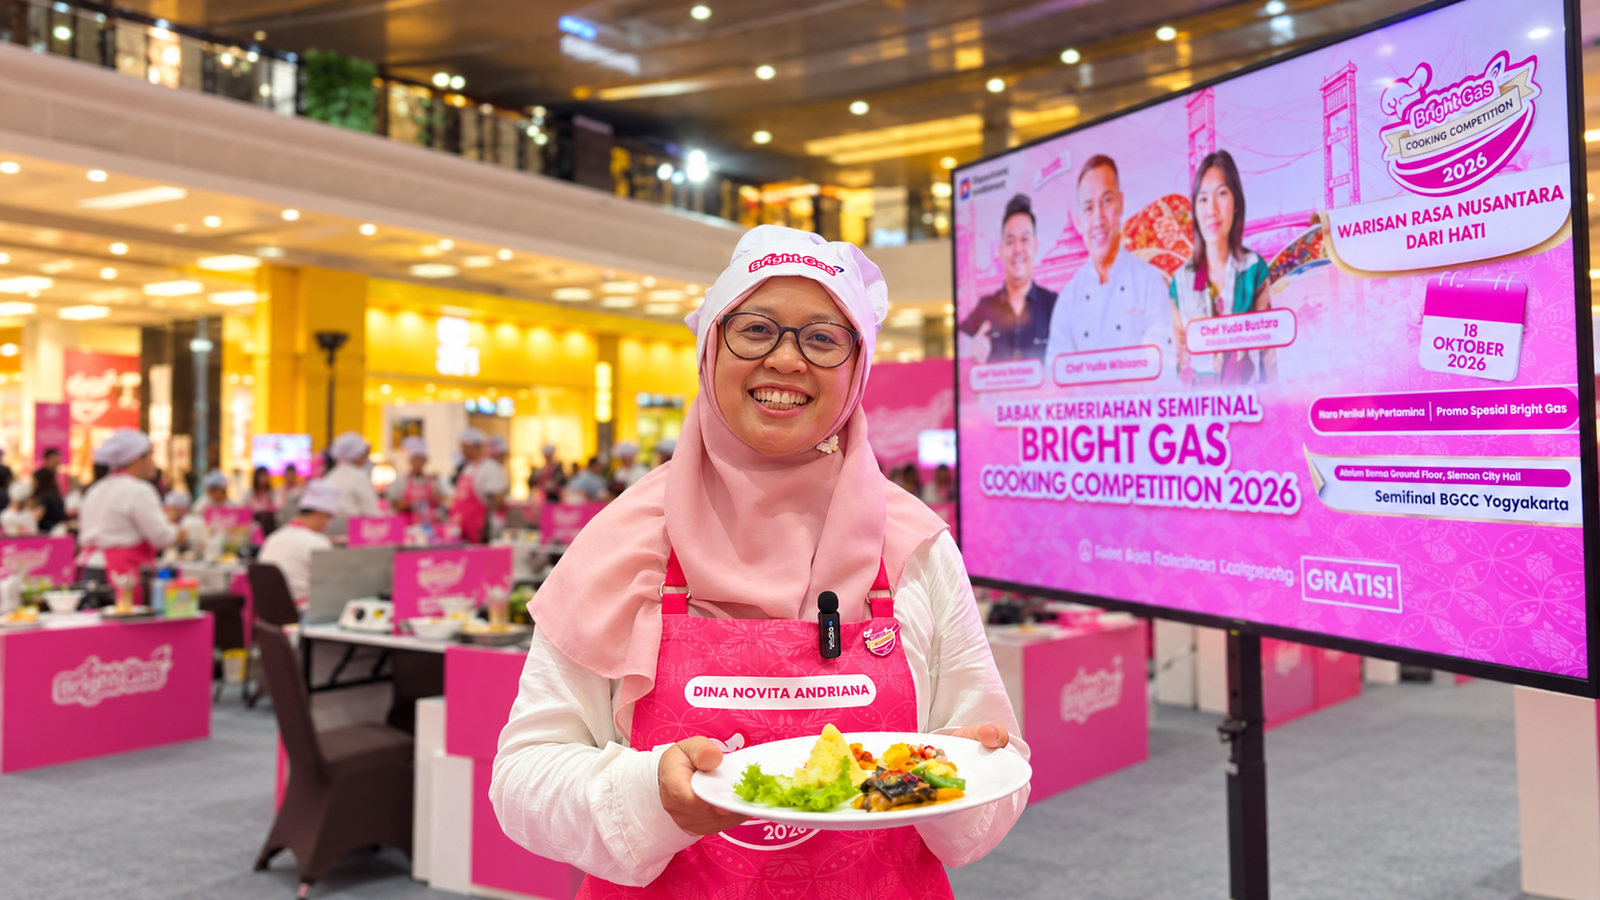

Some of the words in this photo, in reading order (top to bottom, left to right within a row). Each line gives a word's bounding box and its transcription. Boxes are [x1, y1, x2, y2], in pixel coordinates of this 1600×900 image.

[1413, 95, 1460, 128] Bright
[1461, 80, 1494, 107] Gas
[1405, 131, 1447, 151] COOKING
[1449, 97, 1514, 137] COMPETITION
[1442, 152, 1488, 183] 2026
[1337, 213, 1407, 238] WARISAN
[1412, 204, 1454, 226] RASA
[1457, 184, 1564, 218] NUSANTARA
[1406, 230, 1443, 249] DARI
[1449, 222, 1486, 244] HATI
[748, 253, 802, 273] Bright
[802, 255, 836, 276] Gas
[1463, 323, 1478, 338] 18
[1433, 336, 1504, 357] OKTOBER
[1447, 353, 1487, 371] 2026
[997, 404, 1042, 422] BABAK
[1046, 398, 1152, 421] KEMERIAHAN
[1157, 394, 1259, 418] SEMIFINAL
[1366, 406, 1426, 421] MyPertamina
[1436, 406, 1469, 417] Promo
[1470, 404, 1508, 419] Spesial
[1509, 403, 1543, 418] Bright
[1544, 403, 1568, 414] Gas
[1021, 424, 1140, 464] BRIGHT
[1148, 421, 1228, 467] GAS
[1390, 469, 1420, 479] Ground
[1421, 470, 1446, 481] Floor,
[1482, 471, 1500, 483] City
[1502, 472, 1521, 482] Hall
[982, 469, 1067, 495] COOKING
[1071, 471, 1222, 504] COMPETITION
[1228, 476, 1297, 509] 2026
[1375, 490, 1435, 505] Semifinal
[1440, 493, 1480, 507] BGCC
[1483, 494, 1569, 513] Yogyakarta
[1306, 568, 1394, 600] GRATIS!
[693, 686, 729, 698] DINA
[733, 687, 790, 699] NOVITA
[794, 684, 870, 699] ANDRIANA
